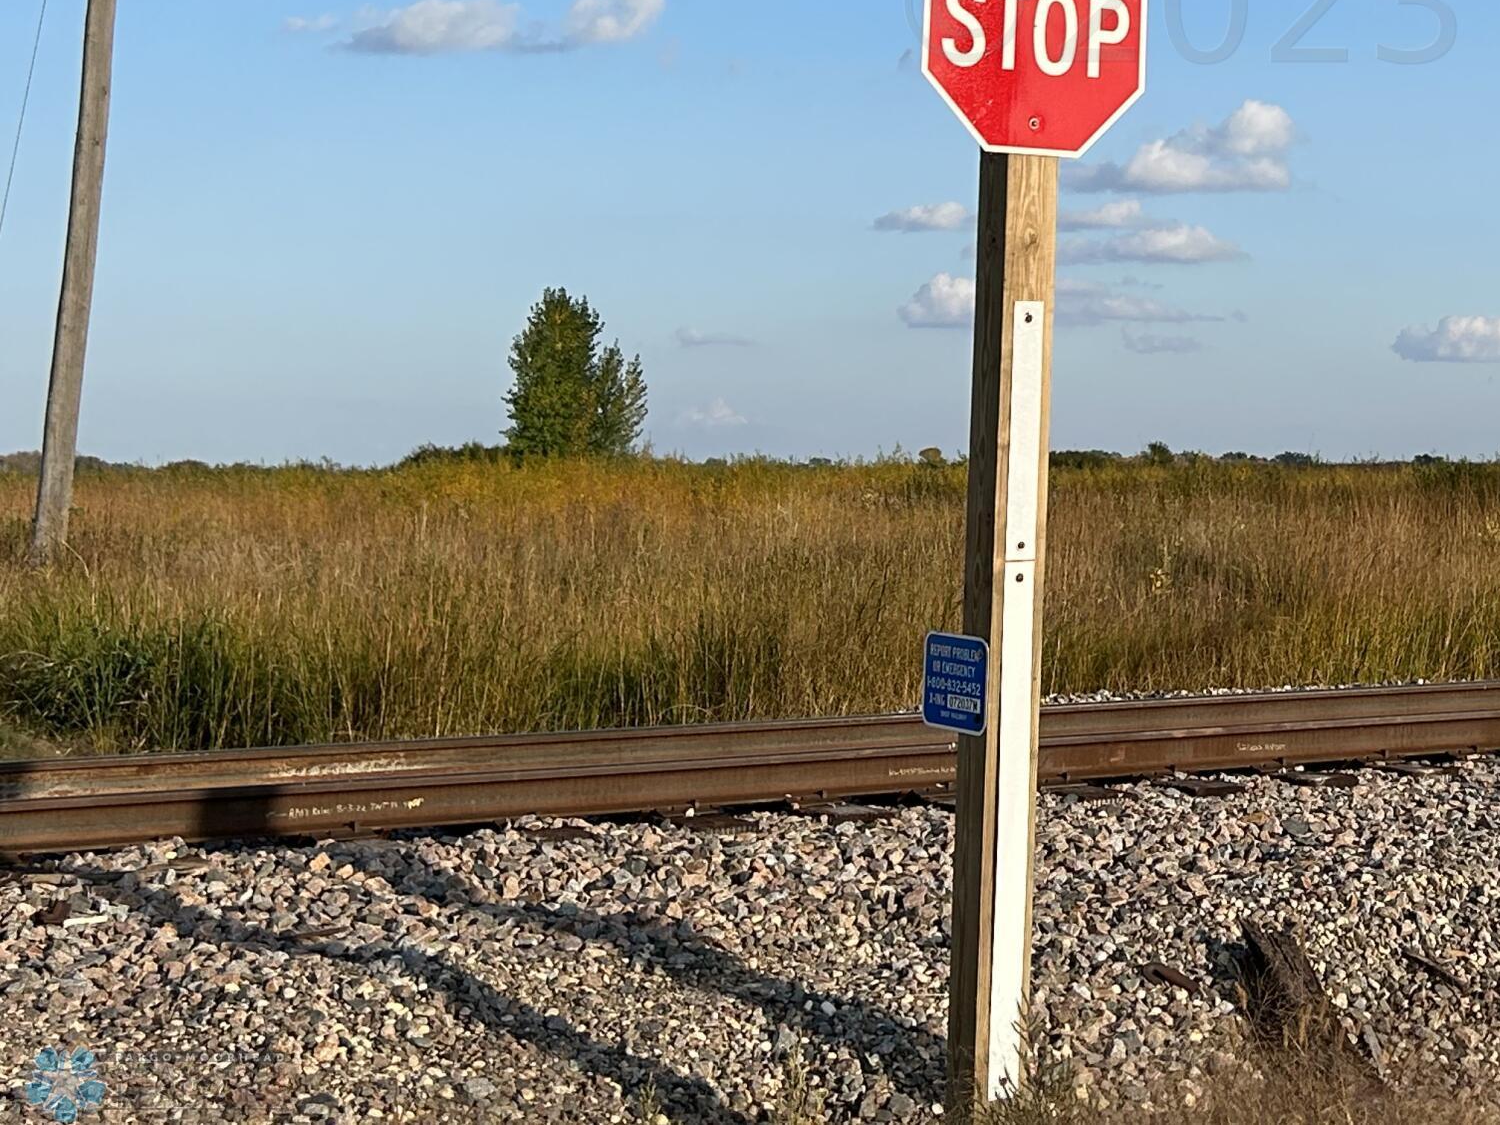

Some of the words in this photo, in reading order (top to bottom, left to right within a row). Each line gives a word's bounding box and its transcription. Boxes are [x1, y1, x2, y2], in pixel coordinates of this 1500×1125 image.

[930, 643, 951, 658] REPORT
[942, 661, 976, 678] EMERGENCY
[927, 675, 981, 696] 1-800-832-5452
